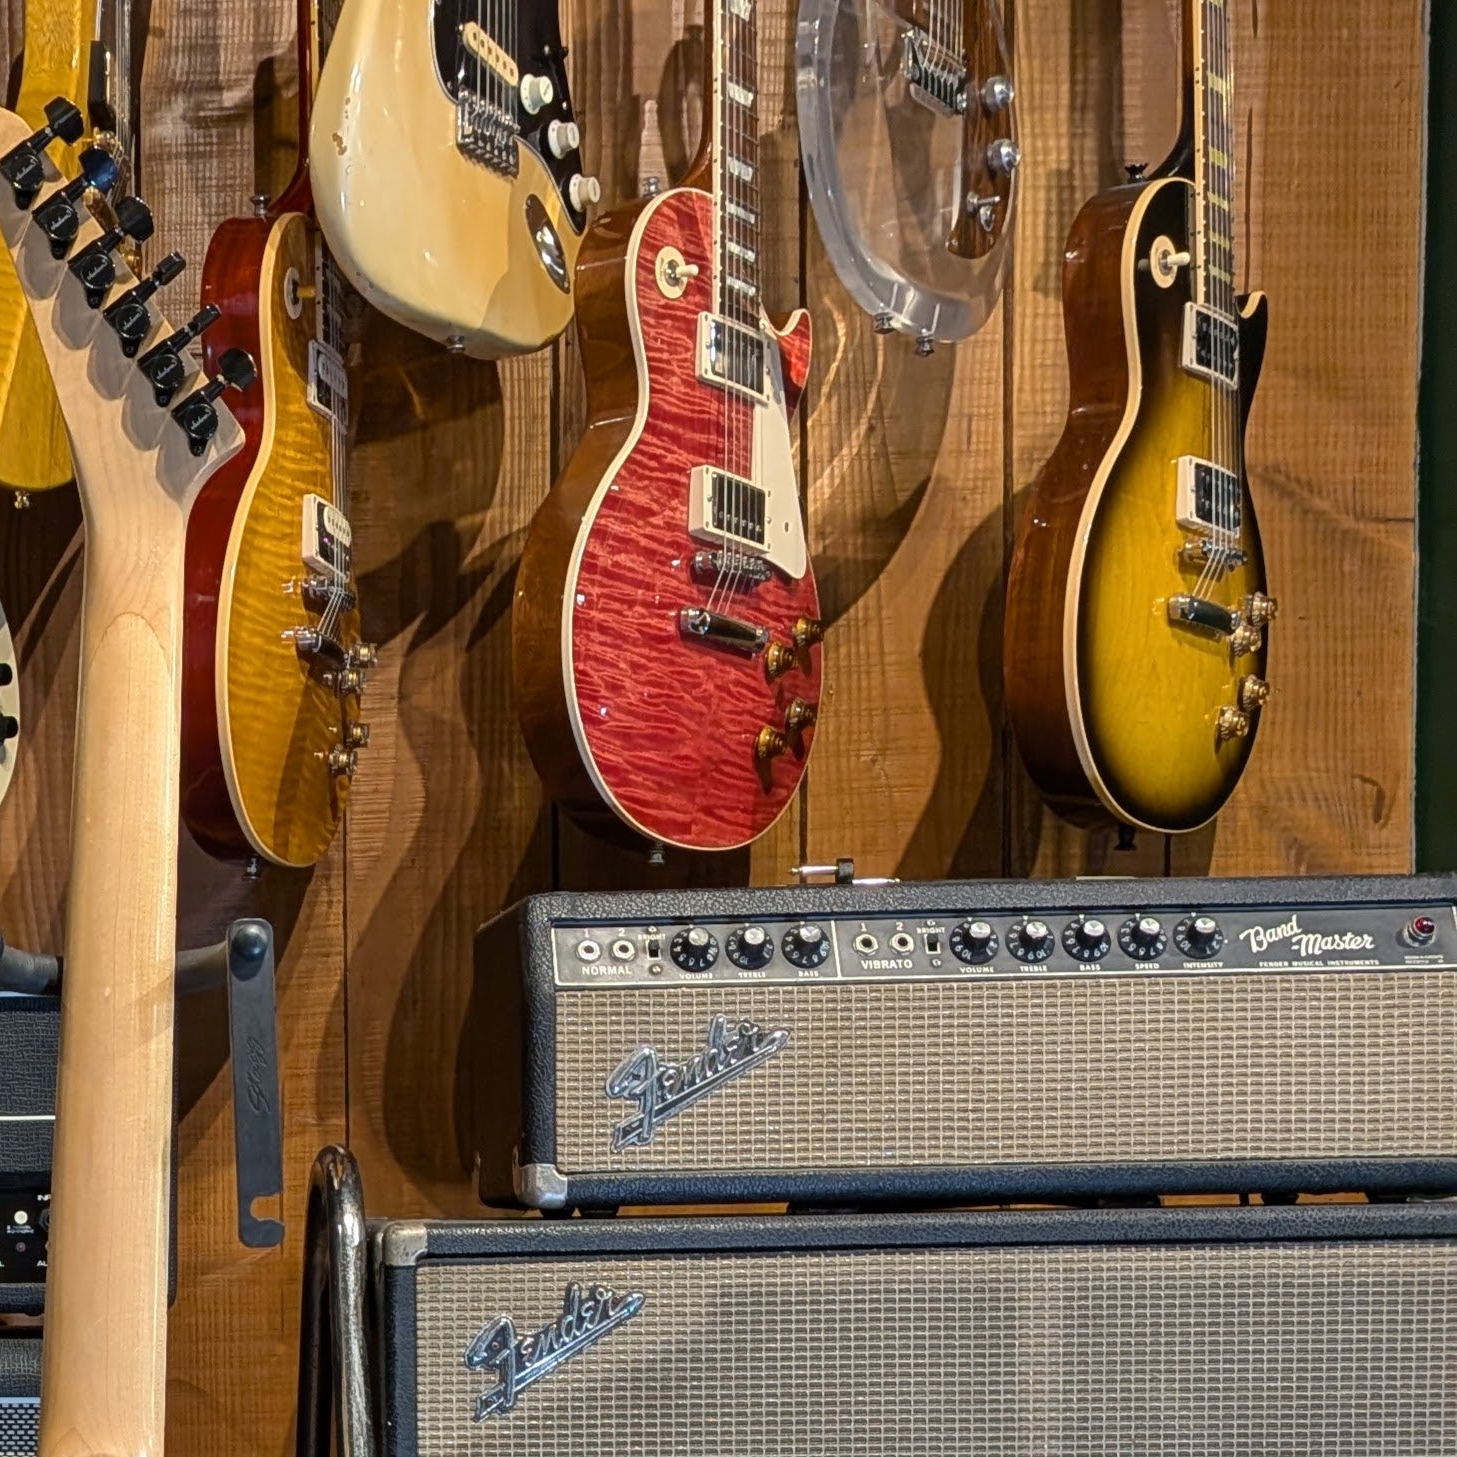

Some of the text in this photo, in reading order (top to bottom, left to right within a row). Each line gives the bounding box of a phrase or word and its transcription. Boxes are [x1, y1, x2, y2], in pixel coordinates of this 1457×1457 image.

[860, 921, 904, 932] 1 2
[916, 926, 945, 934] BRIGHT
[583, 928, 626, 938] 1 2
[637, 933, 666, 941] BRIGHT
[1239, 914, 1302, 953] Band
[861, 959, 913, 969] VIBRATO
[582, 965, 632, 975] NORMAL
[606, 1013, 791, 1153] Fender
[464, 1280, 646, 1423] Fender
